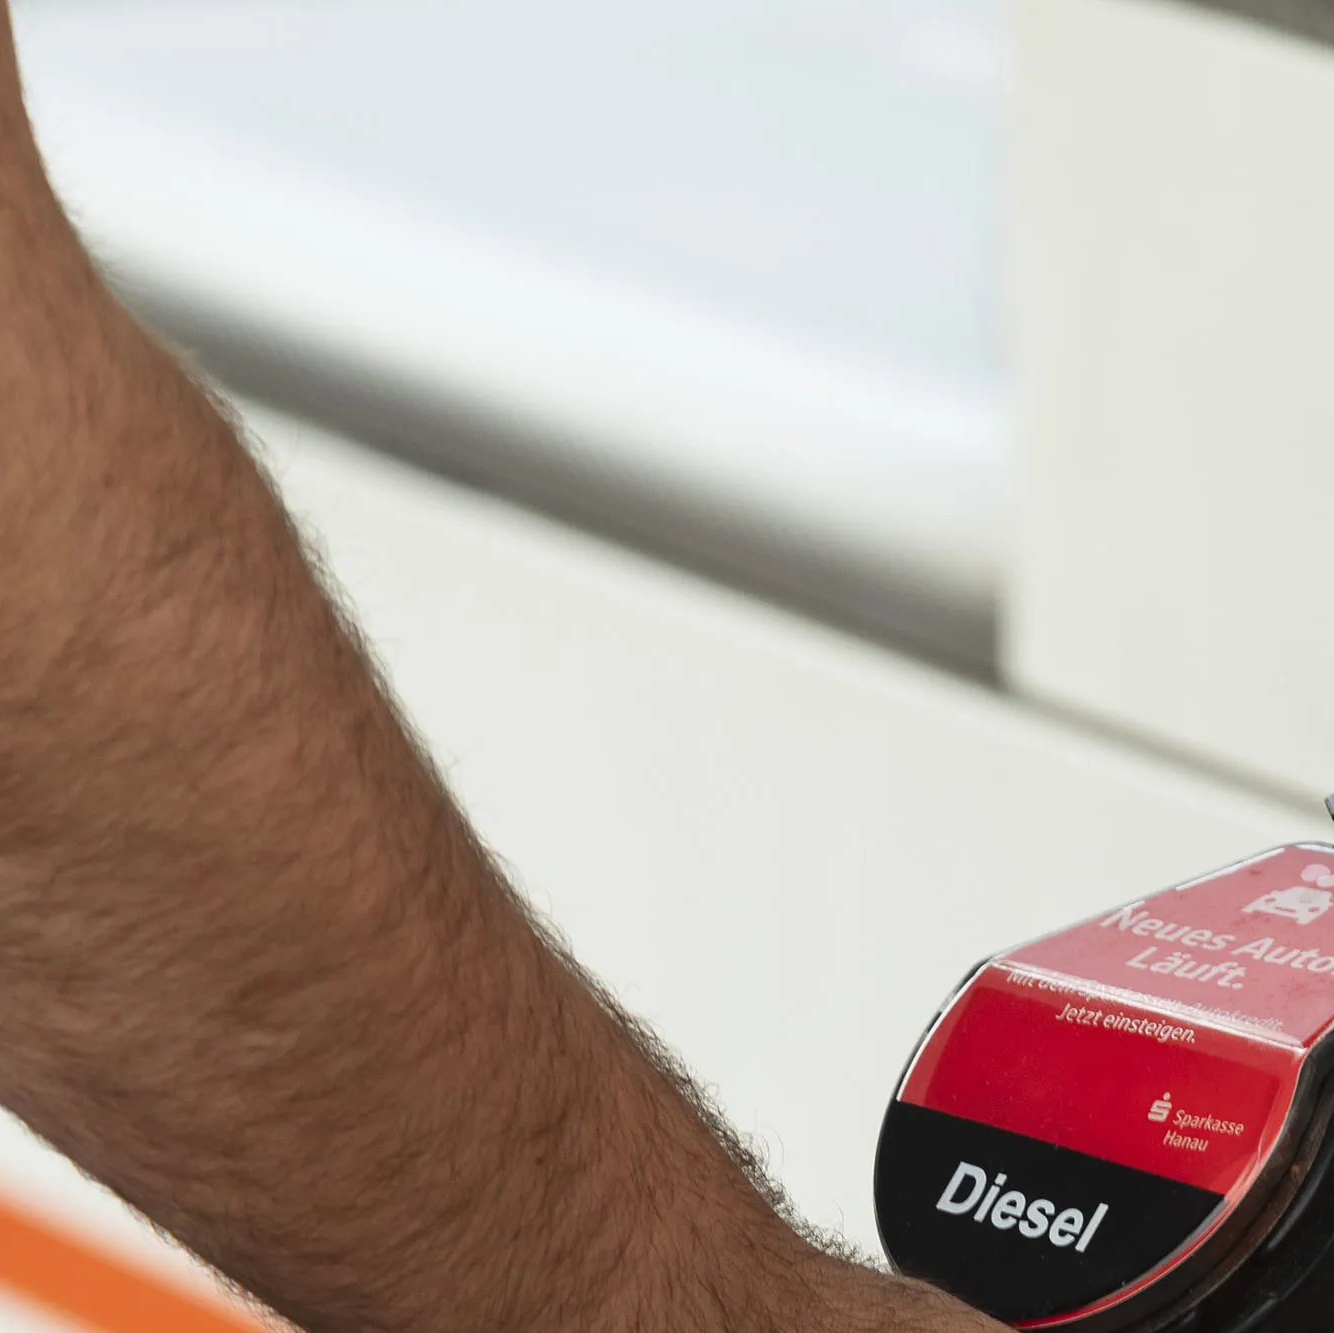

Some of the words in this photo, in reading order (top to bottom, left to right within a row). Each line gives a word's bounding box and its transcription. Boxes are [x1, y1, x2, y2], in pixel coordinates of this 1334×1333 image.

[1100, 901, 1235, 951] Neues
[1126, 946, 1247, 990] Läuft.
[1055, 1002, 1103, 1028] Jetzt
[1103, 1011, 1197, 1044] einsteigen.
[1162, 1129, 1209, 1152] Hanau
[1172, 1109, 1245, 1136] Sparkasse
[935, 1161, 1110, 1253] Diesel
